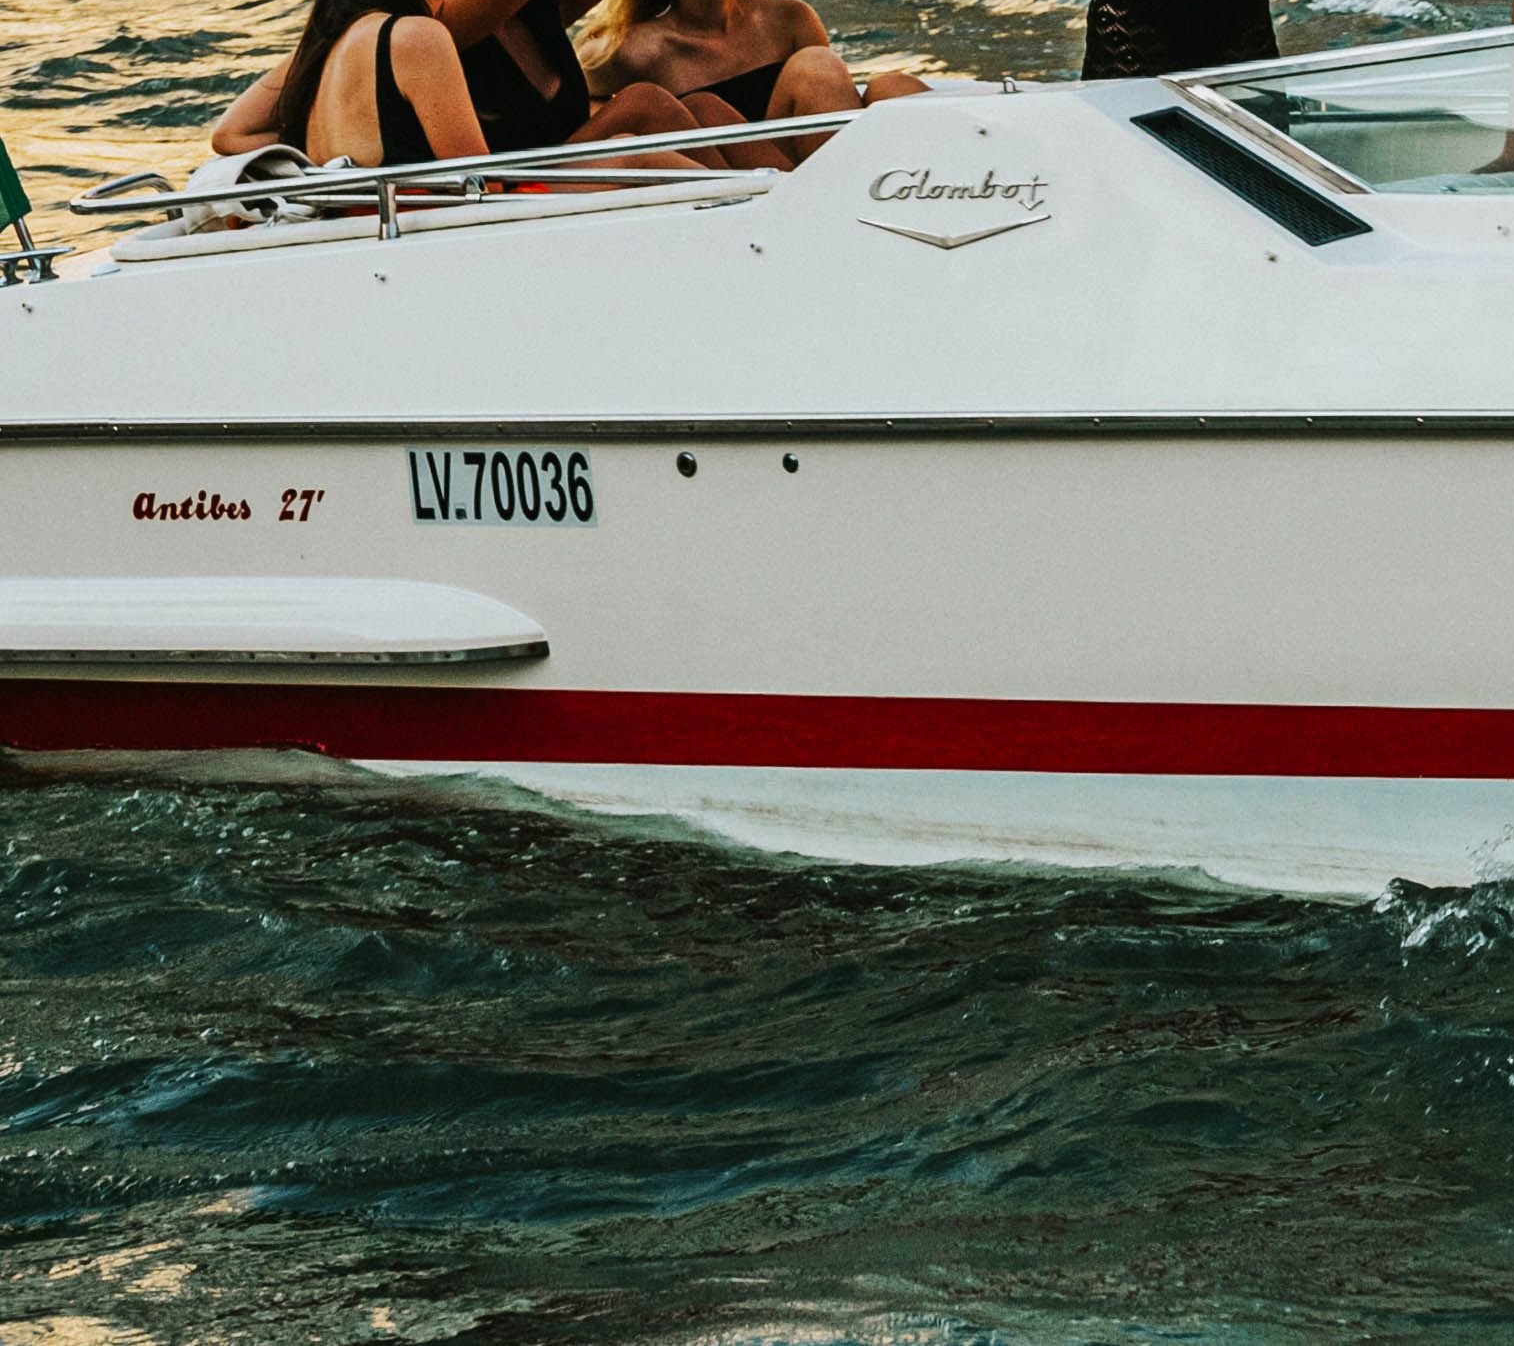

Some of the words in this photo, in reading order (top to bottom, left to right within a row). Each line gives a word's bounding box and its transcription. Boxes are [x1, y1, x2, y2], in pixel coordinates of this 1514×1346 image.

[868, 169, 1022, 201] Colombo
[409, 451, 594, 522] LV.70036
[132, 489, 252, 521] Antibes
